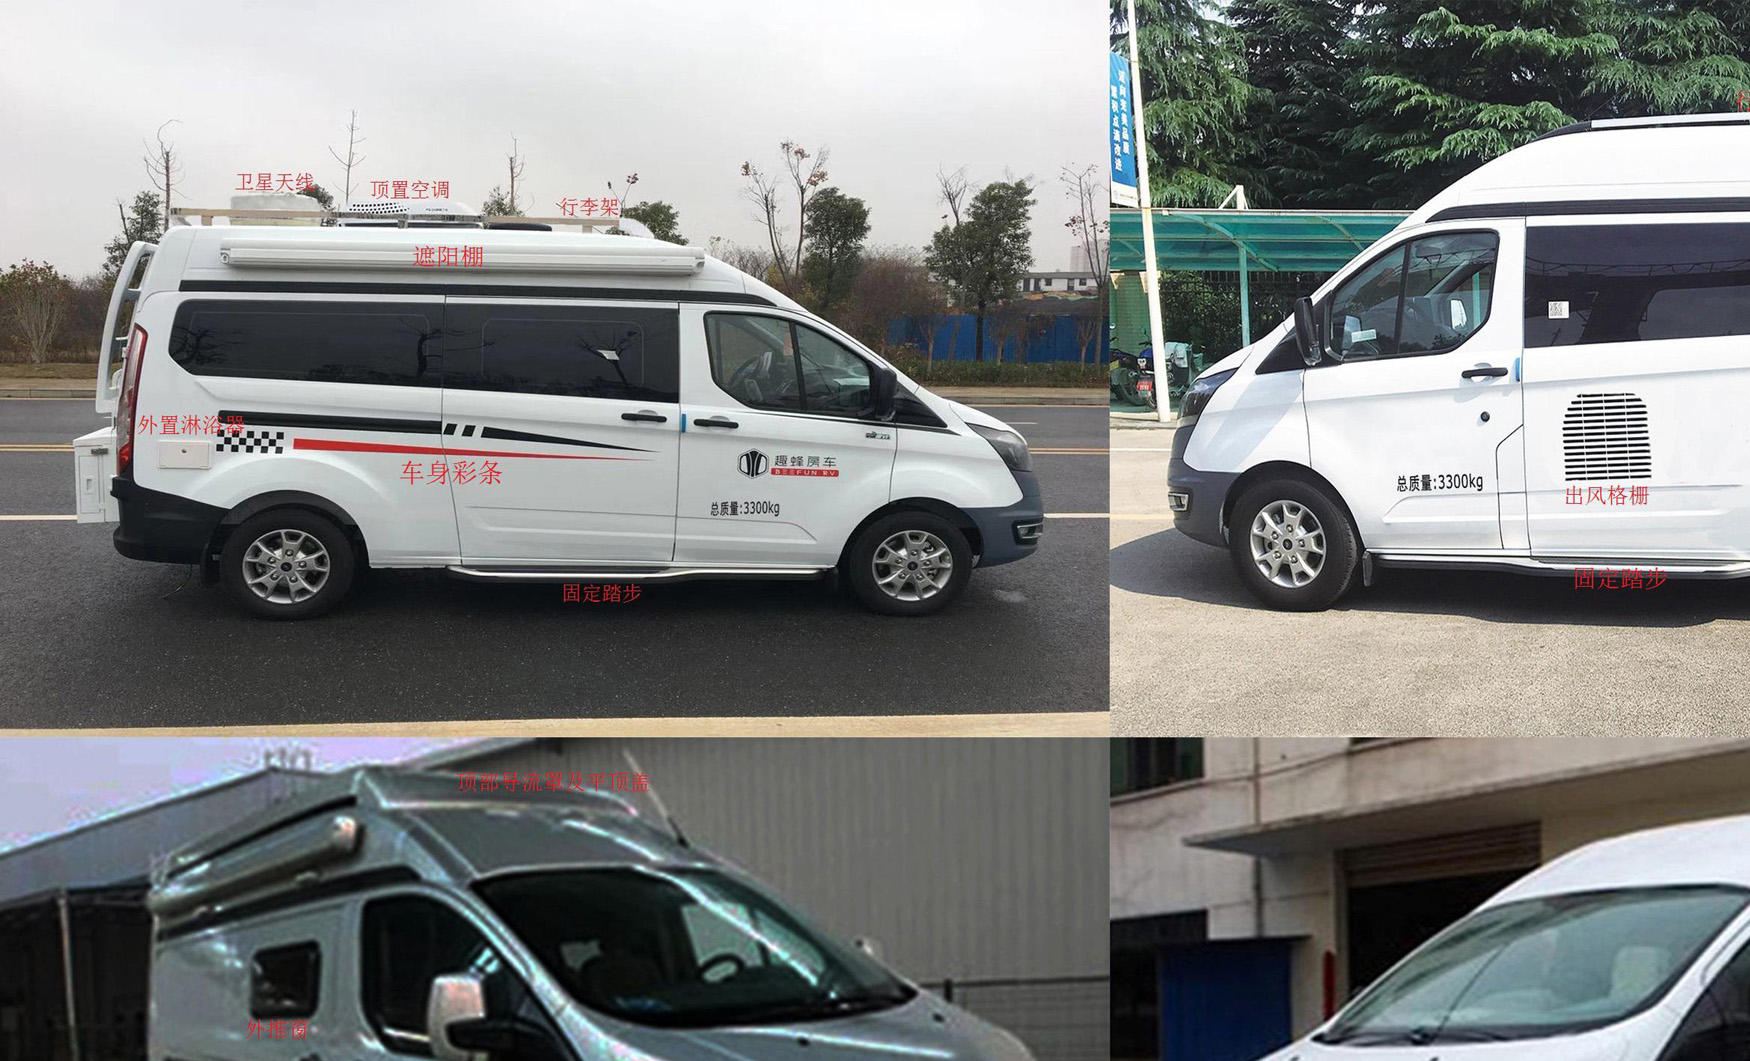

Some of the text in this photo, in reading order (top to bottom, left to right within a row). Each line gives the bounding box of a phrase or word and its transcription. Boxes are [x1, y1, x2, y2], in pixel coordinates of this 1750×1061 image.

[774, 454, 837, 468] 趣蜂房车
[1396, 473, 1484, 493] 总质量:3300kg
[710, 500, 780, 517] 总质量:3300kg
